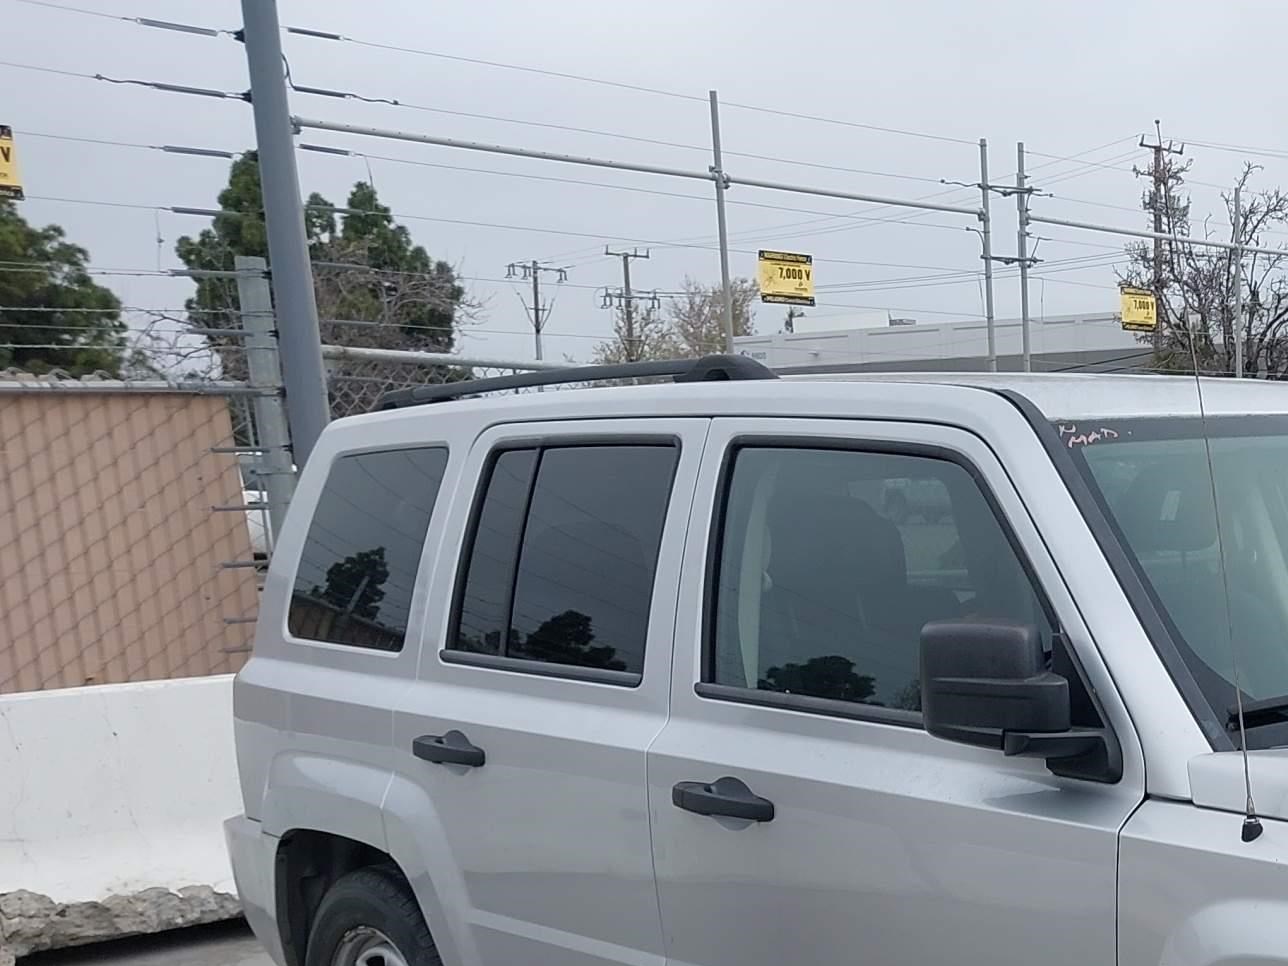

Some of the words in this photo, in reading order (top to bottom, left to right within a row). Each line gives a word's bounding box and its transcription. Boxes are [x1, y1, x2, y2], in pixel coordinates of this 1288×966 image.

[778, 266, 803, 280] 7,000
[805, 269, 811, 281] V
[1134, 299, 1150, 311] 7,000
